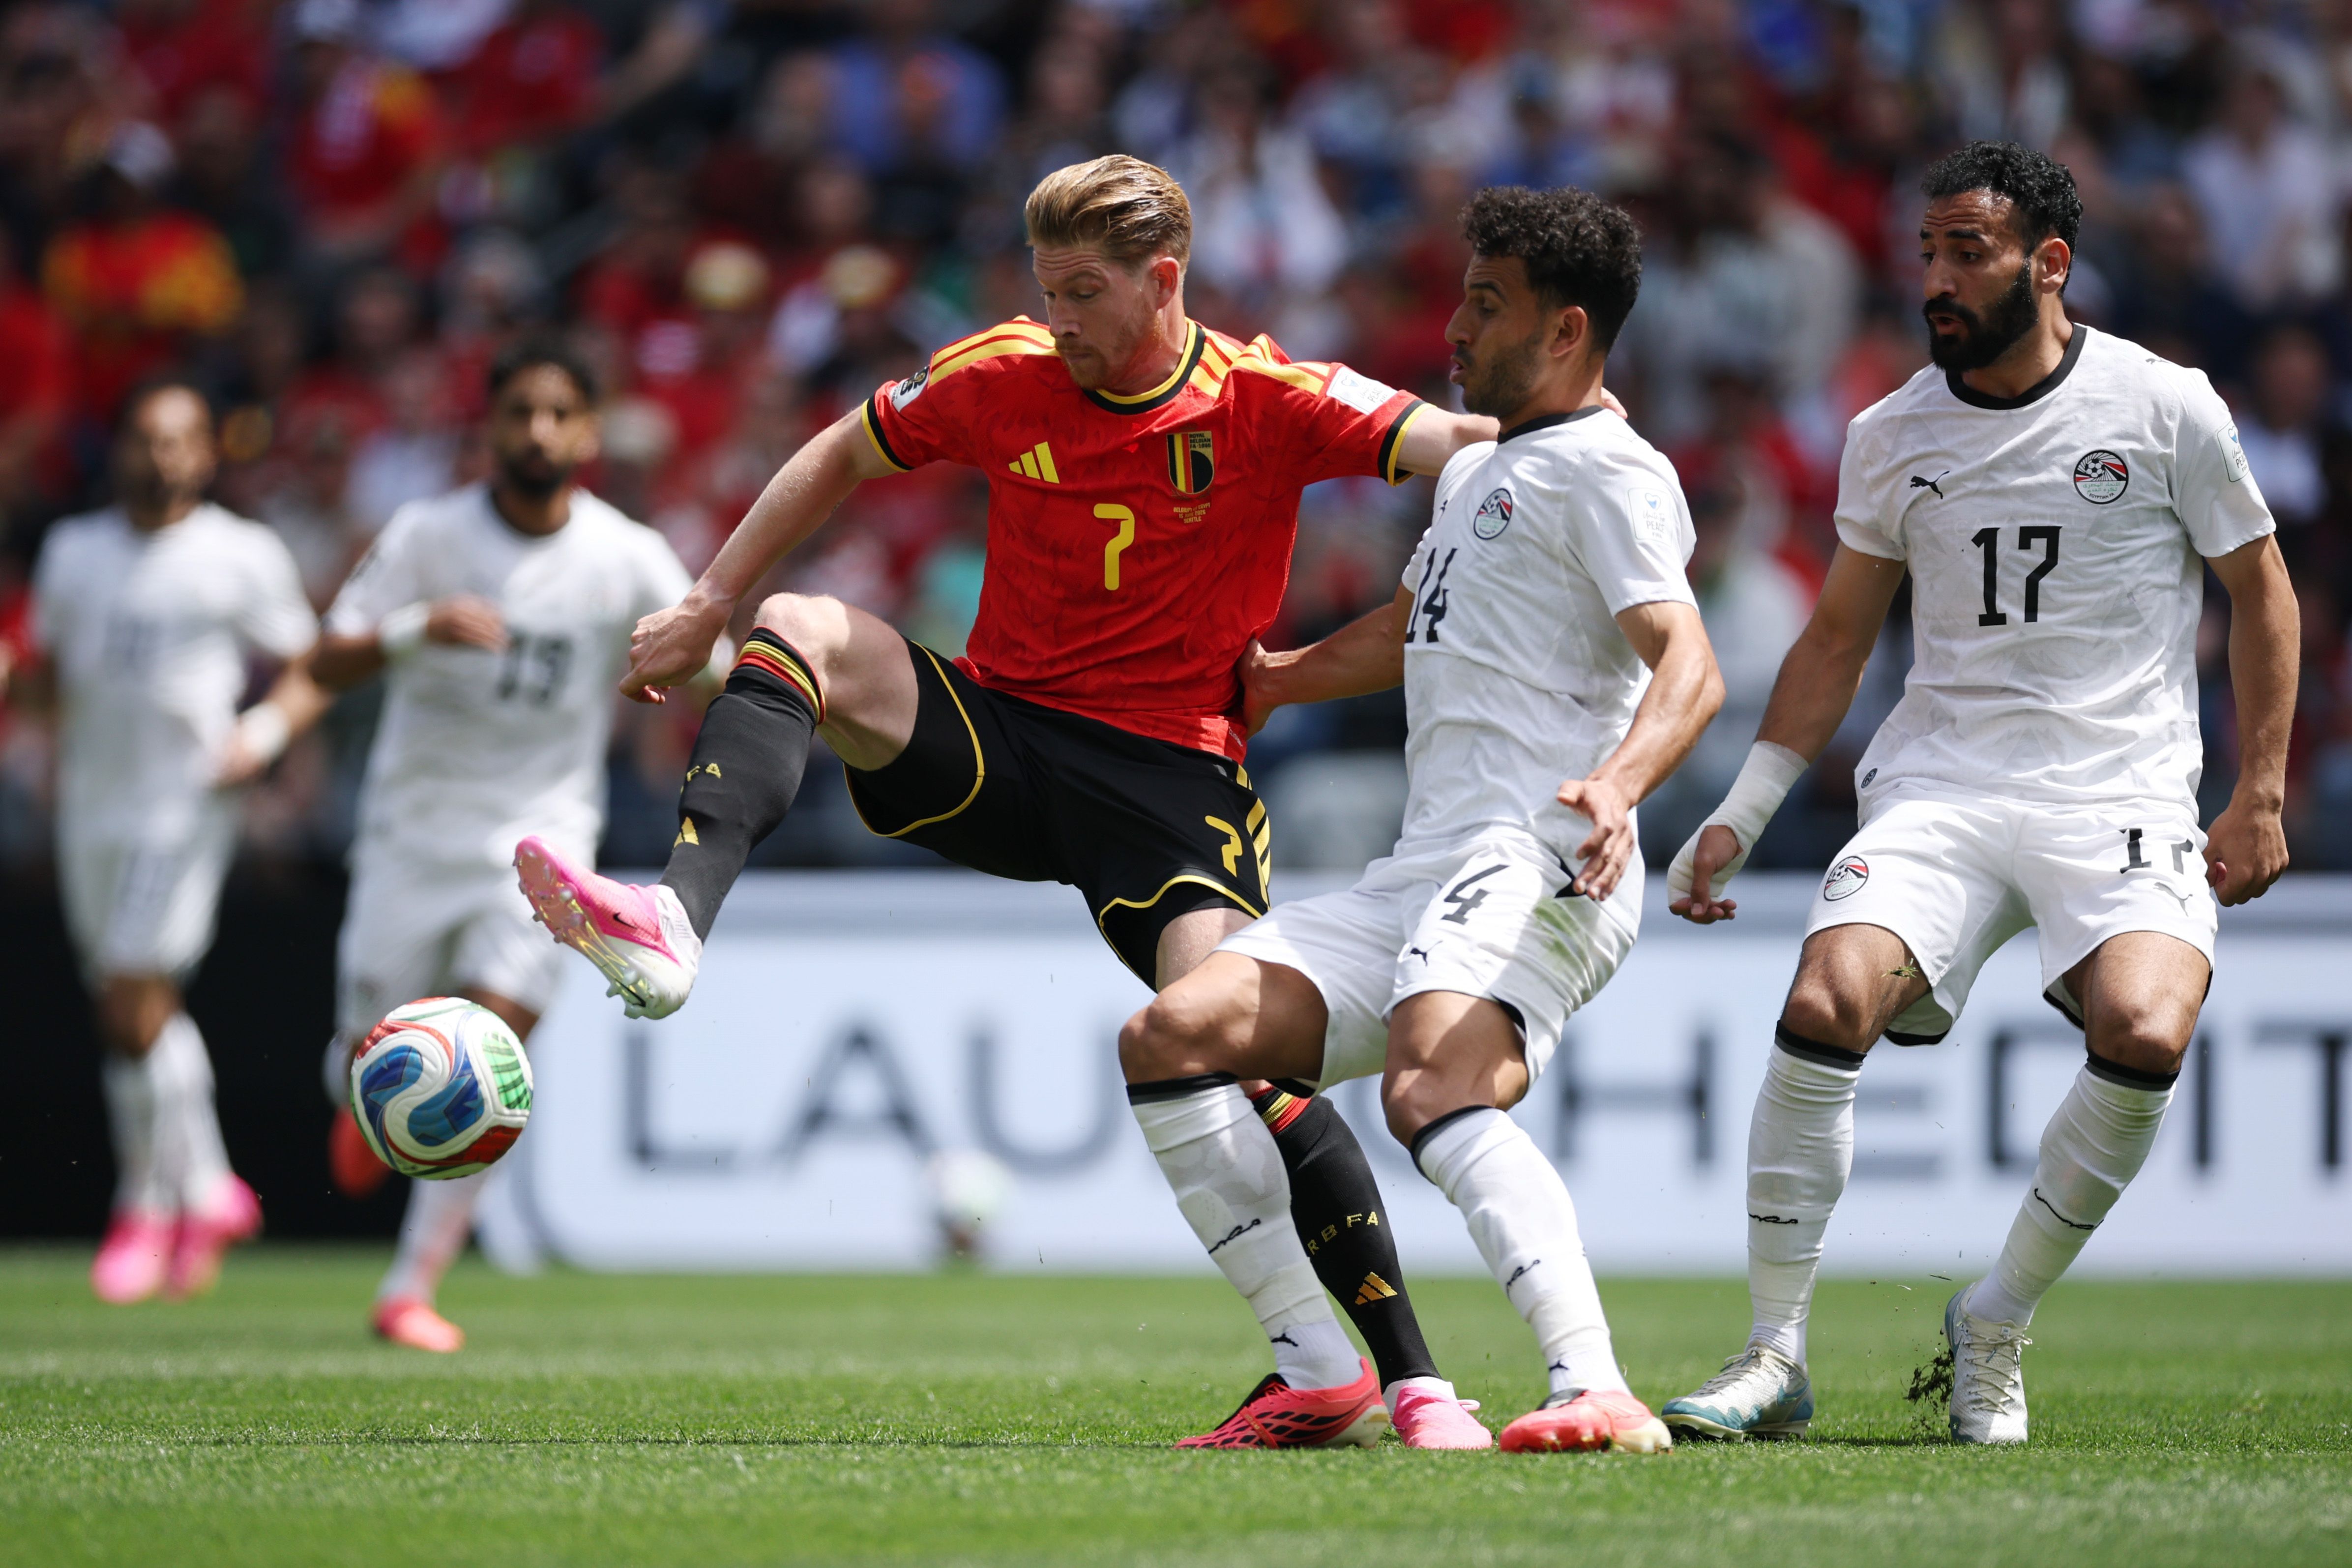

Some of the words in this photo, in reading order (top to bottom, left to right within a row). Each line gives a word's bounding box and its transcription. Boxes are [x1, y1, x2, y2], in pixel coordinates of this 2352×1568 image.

[1093, 503, 1135, 591] 7
[1970, 525, 2063, 626] 17
[1405, 547, 1458, 643] 14
[1205, 815, 1243, 878] 7
[1441, 864, 1511, 925] 4
